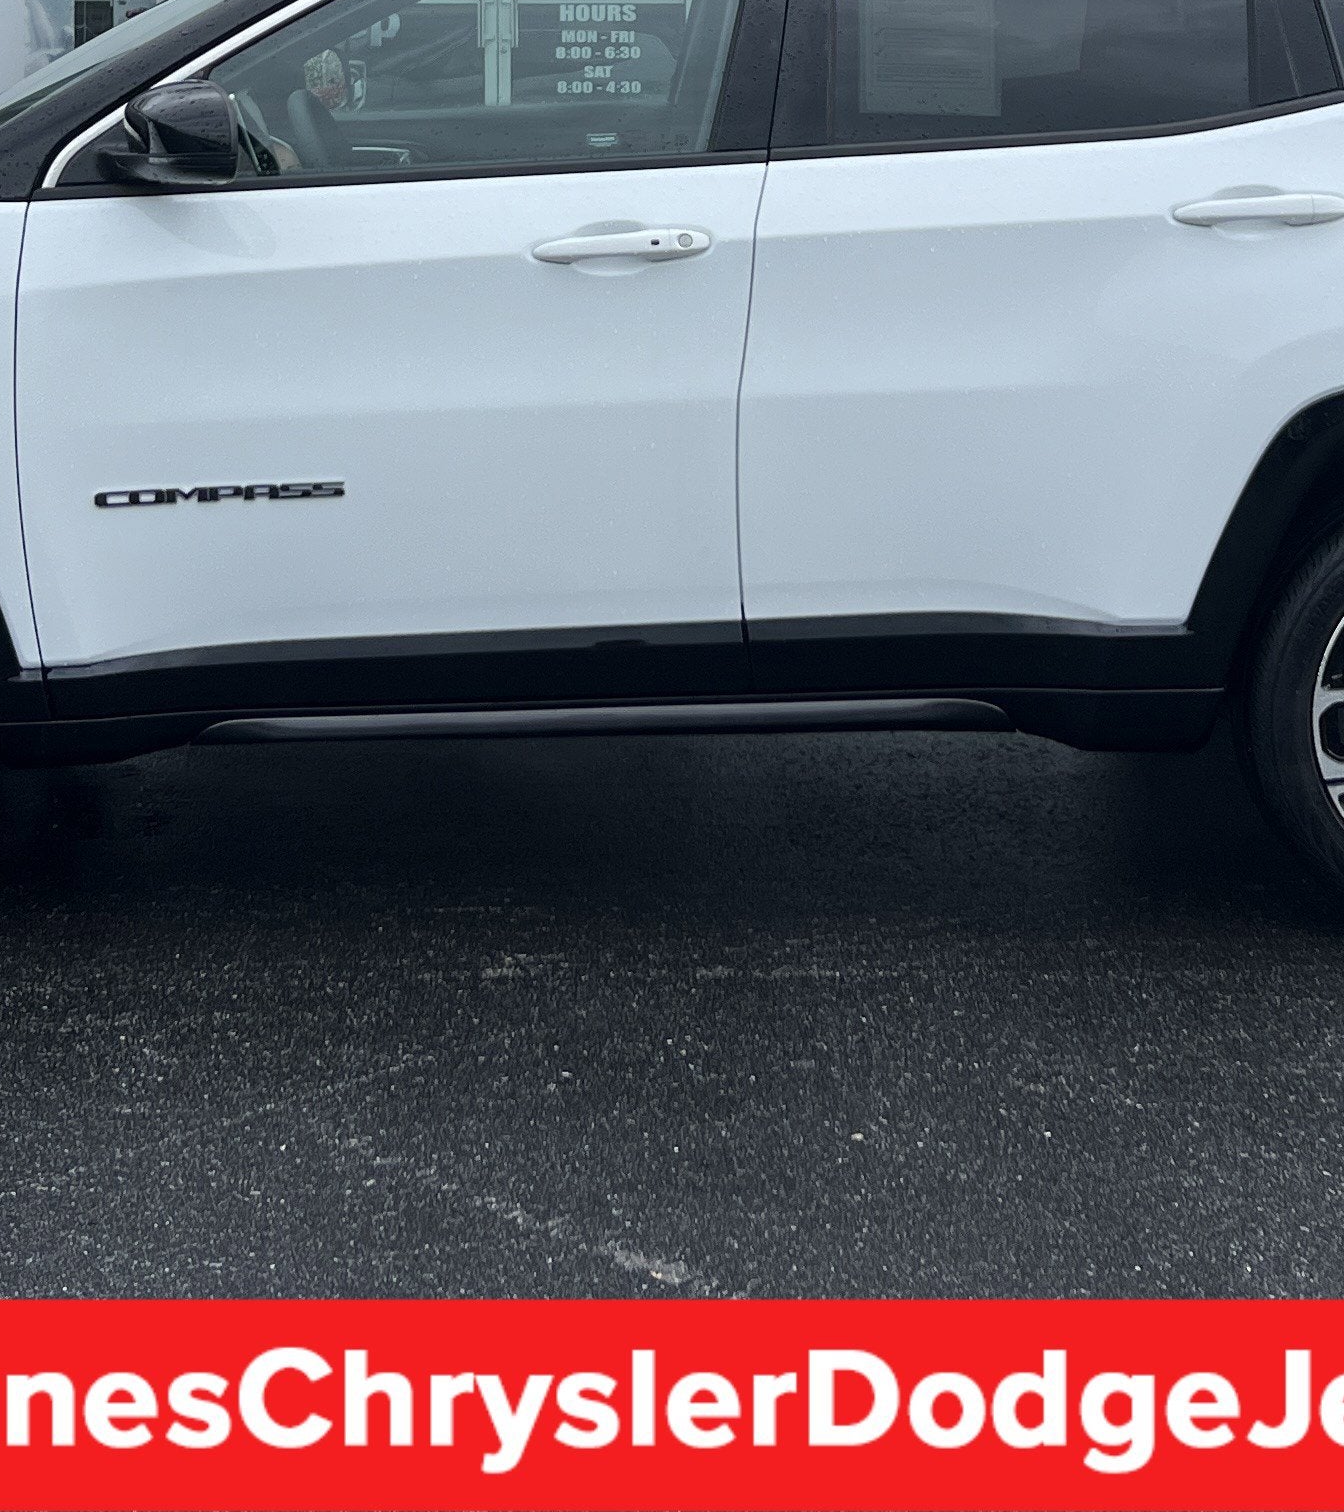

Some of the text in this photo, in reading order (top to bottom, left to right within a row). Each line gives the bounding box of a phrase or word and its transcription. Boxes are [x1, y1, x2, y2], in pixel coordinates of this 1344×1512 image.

[559, 4, 637, 22] HOURS
[561, 30, 598, 43] MON
[610, 30, 635, 43] FRI
[555, 46, 592, 59] 8:00
[604, 46, 641, 59] 6:30
[583, 65, 613, 78] SAT
[557, 81, 593, 94] 8:00
[605, 80, 642, 94] 4:30
[94, 481, 346, 507] COMPASS
